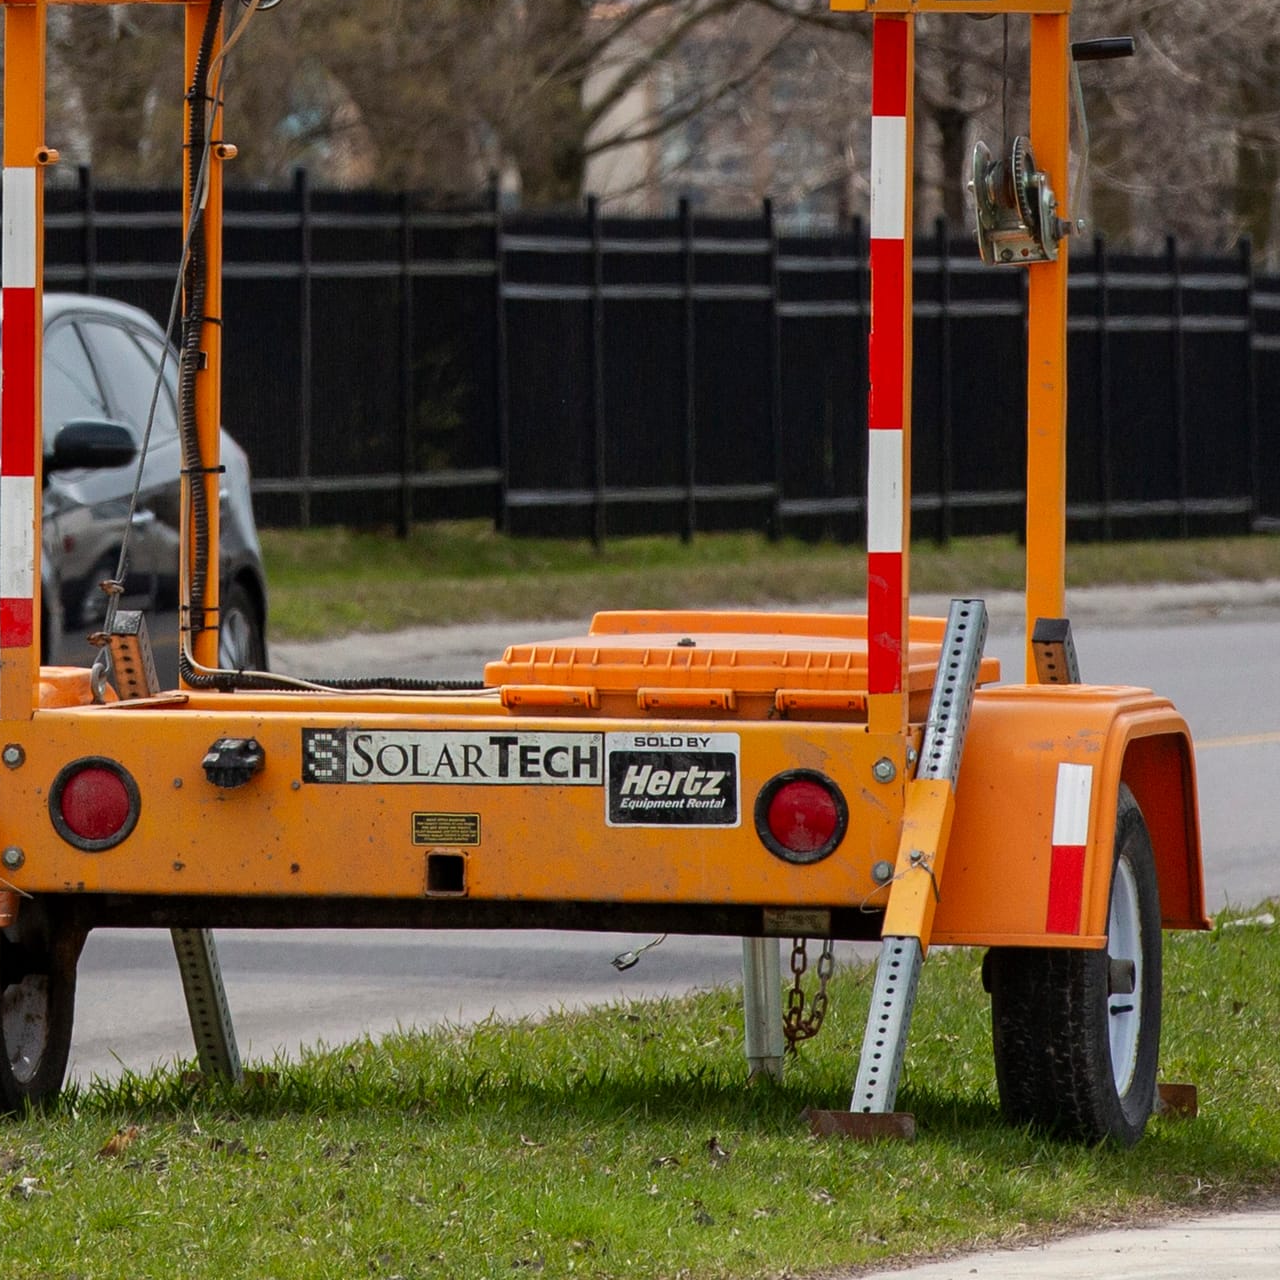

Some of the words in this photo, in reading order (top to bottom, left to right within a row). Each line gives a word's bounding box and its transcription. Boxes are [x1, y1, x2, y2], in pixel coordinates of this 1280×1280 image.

[634, 736, 683, 748] SOLD
[687, 737, 711, 748] BY
[620, 765, 726, 796] Hertz
[620, 797, 684, 810] Equipment
[686, 797, 726, 809] Rental
